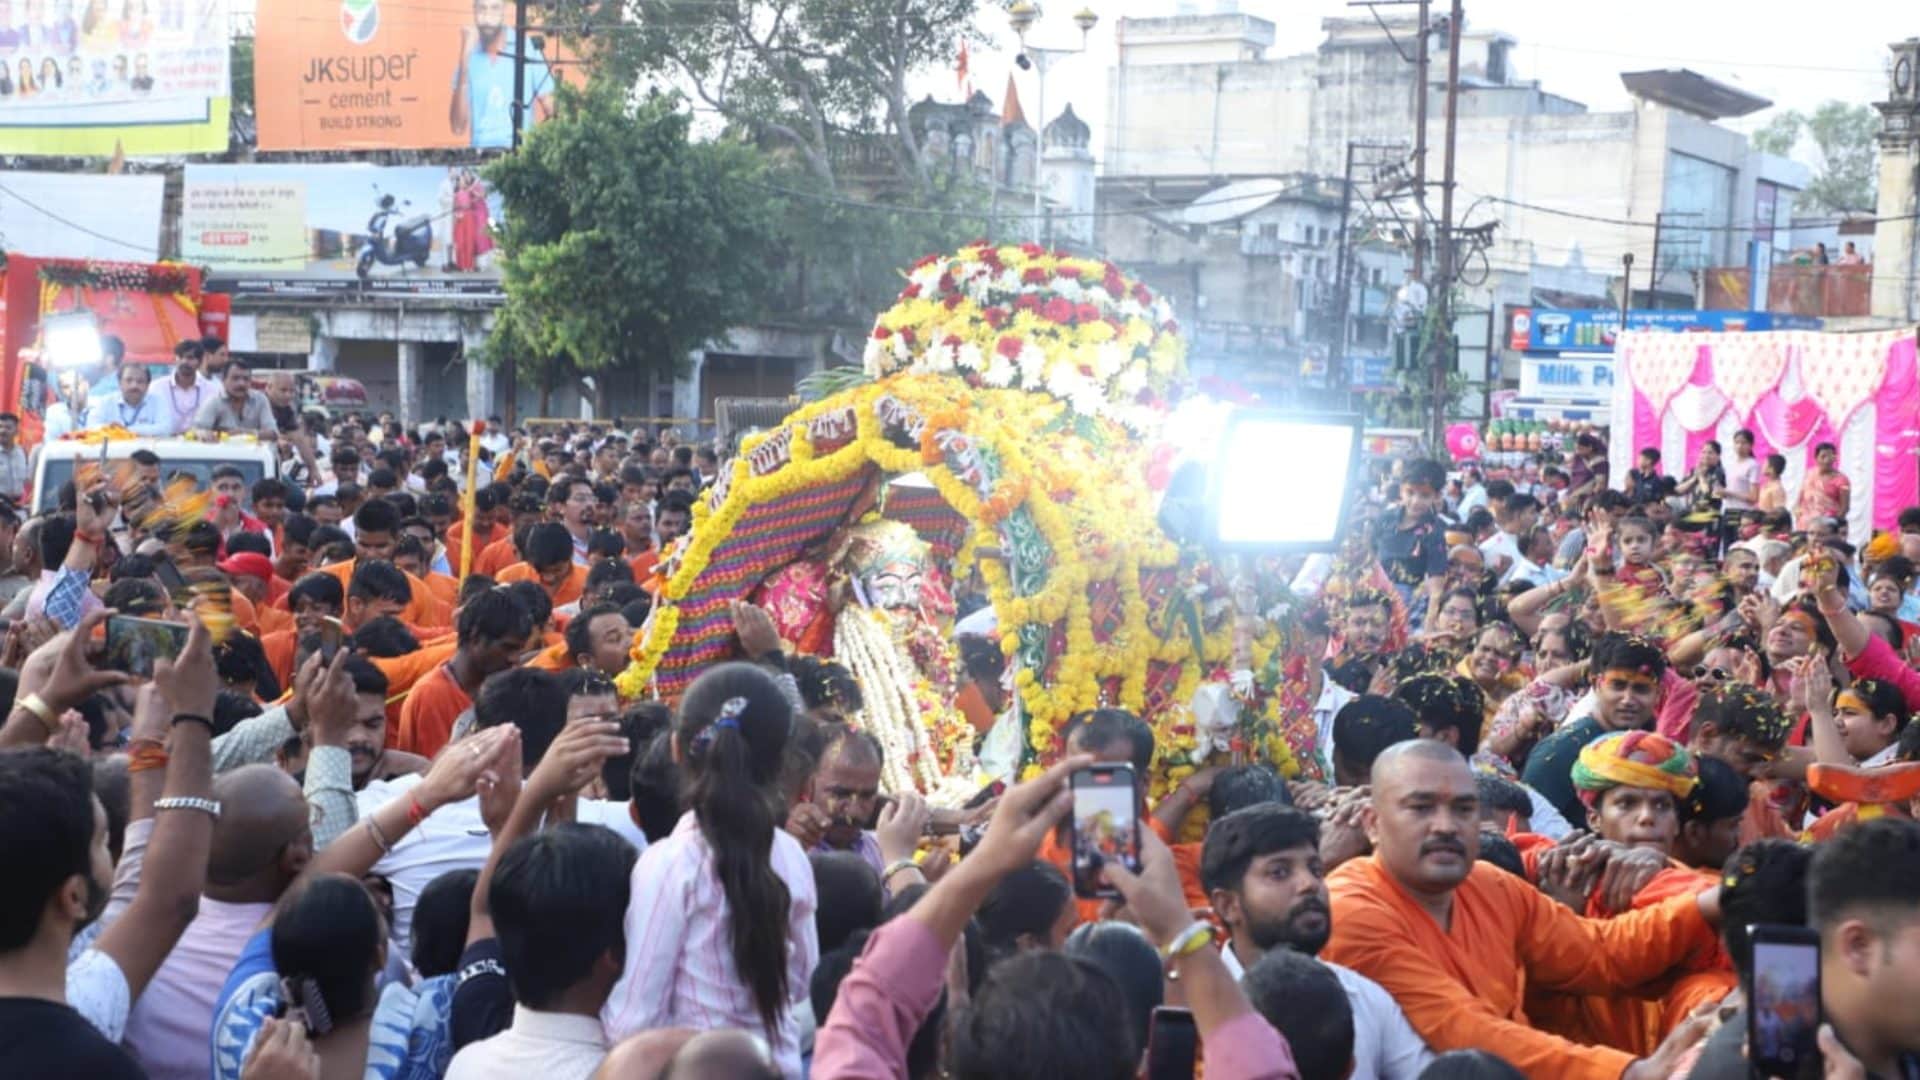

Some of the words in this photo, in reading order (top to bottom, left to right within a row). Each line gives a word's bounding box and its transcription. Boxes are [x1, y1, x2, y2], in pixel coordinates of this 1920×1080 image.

[330, 89, 392, 110] cement
[320, 117, 354, 131] BUILD
[356, 115, 403, 130] STRONG
[1538, 362, 1583, 386] Milk
